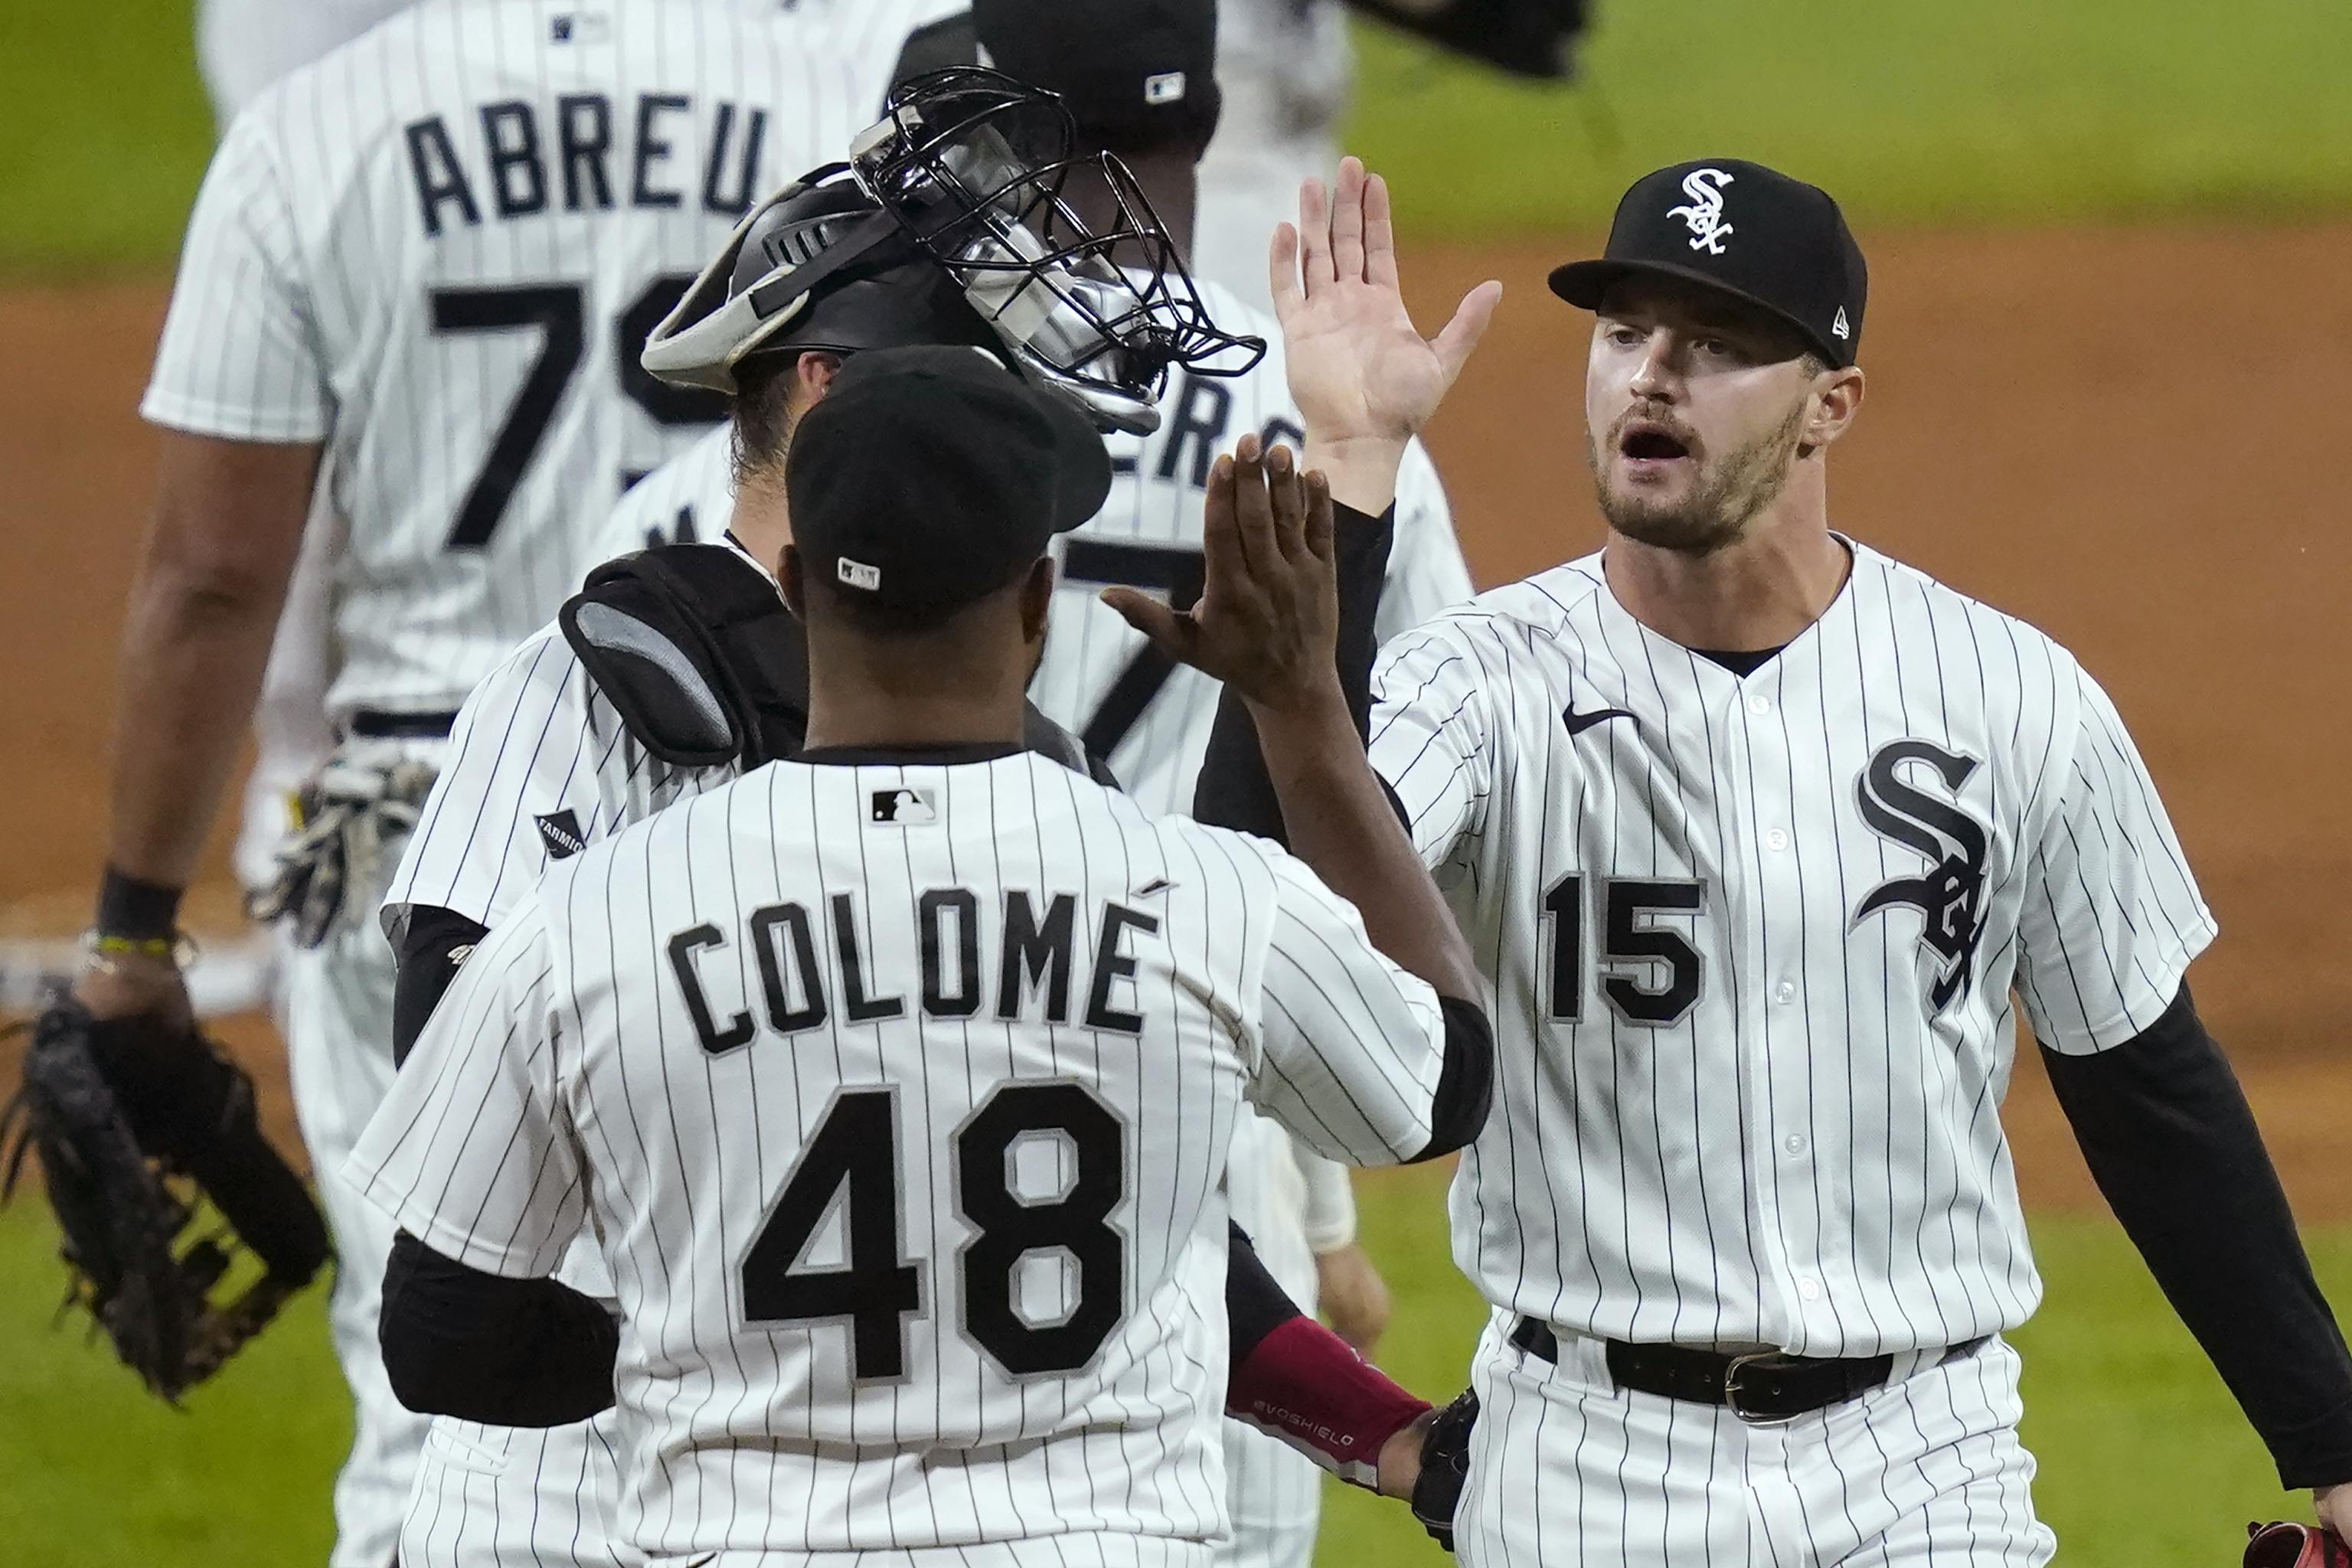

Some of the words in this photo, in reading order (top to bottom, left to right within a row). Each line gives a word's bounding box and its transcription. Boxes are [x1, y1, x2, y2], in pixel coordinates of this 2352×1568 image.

[403, 92, 768, 236] ABREU
[665, 876, 1180, 1060] COLOMÉ
[1538, 870, 1708, 1030] 15
[735, 1075, 1132, 1389] 48
